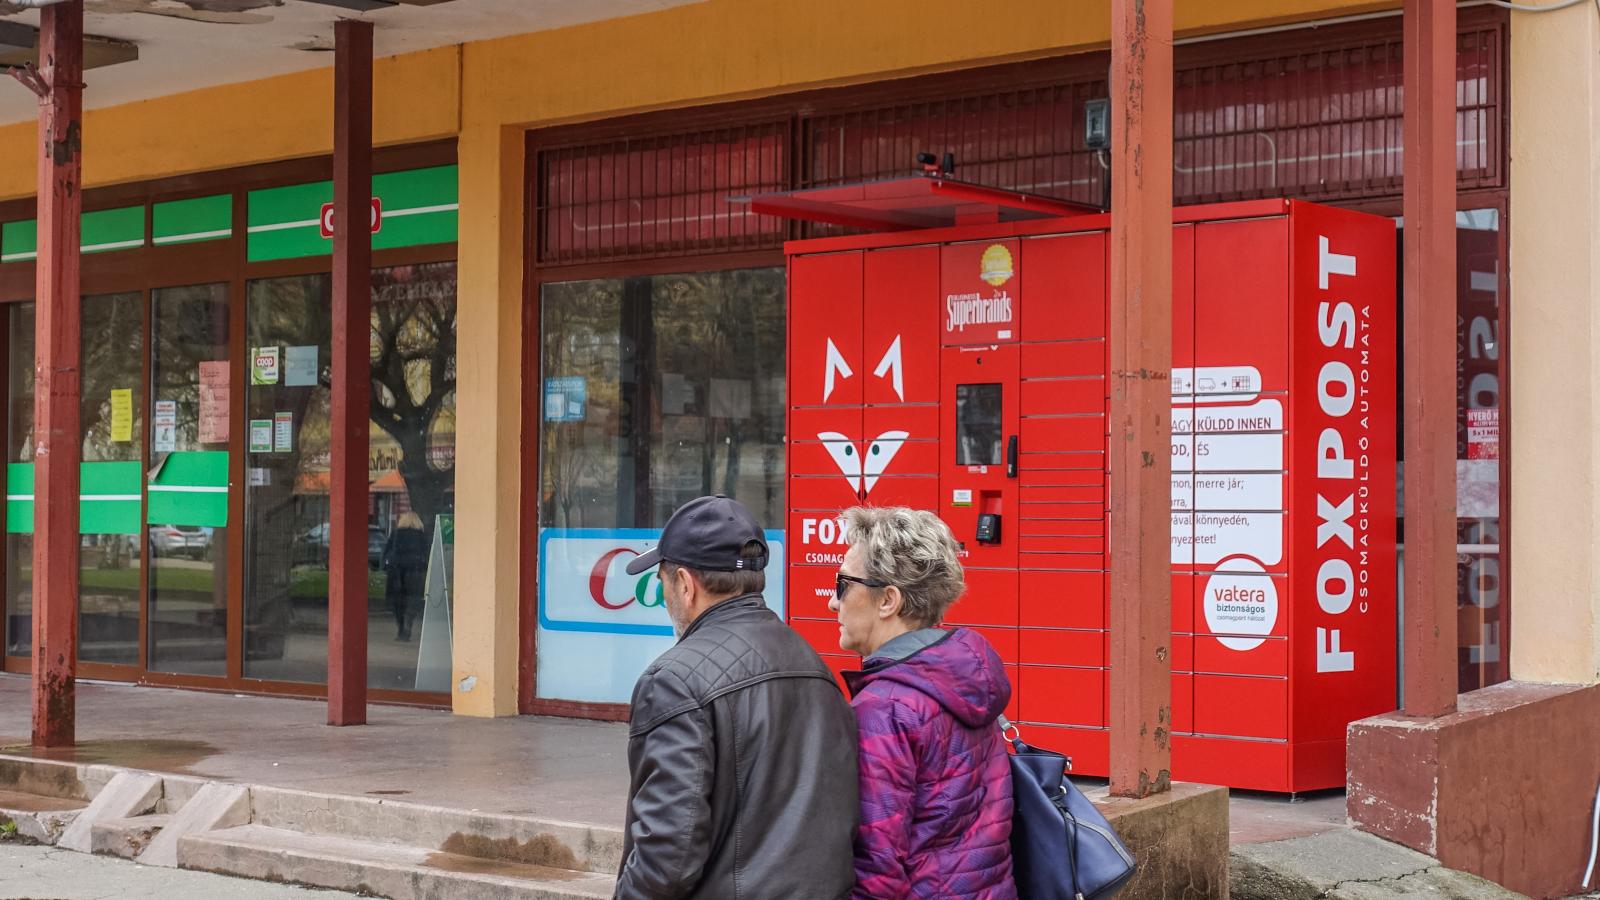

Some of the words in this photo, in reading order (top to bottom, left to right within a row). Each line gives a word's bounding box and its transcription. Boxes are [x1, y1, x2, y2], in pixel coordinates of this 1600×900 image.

[946, 290, 1012, 332] Superbrands
[1360, 305, 1371, 429] AUTOMATA
[1468, 409, 1492, 421] NYERŐ
[1197, 416, 1234, 430] KÜLDD
[1238, 417, 1272, 429] INNEN
[1197, 441, 1210, 456] ÉS
[1316, 235, 1357, 673] FOXPOST
[1196, 479, 1225, 489] merre
[1227, 477, 1244, 491] jár;
[1171, 515, 1192, 525] ával
[1196, 515, 1250, 528] könnyedén,
[1359, 436, 1370, 614] CSOMAGKÜLDŐ
[805, 552, 845, 564] CSOMAG
[589, 547, 665, 610] Co
[1214, 584, 1265, 603] vatera
[1216, 603, 1266, 614] biztonságos
